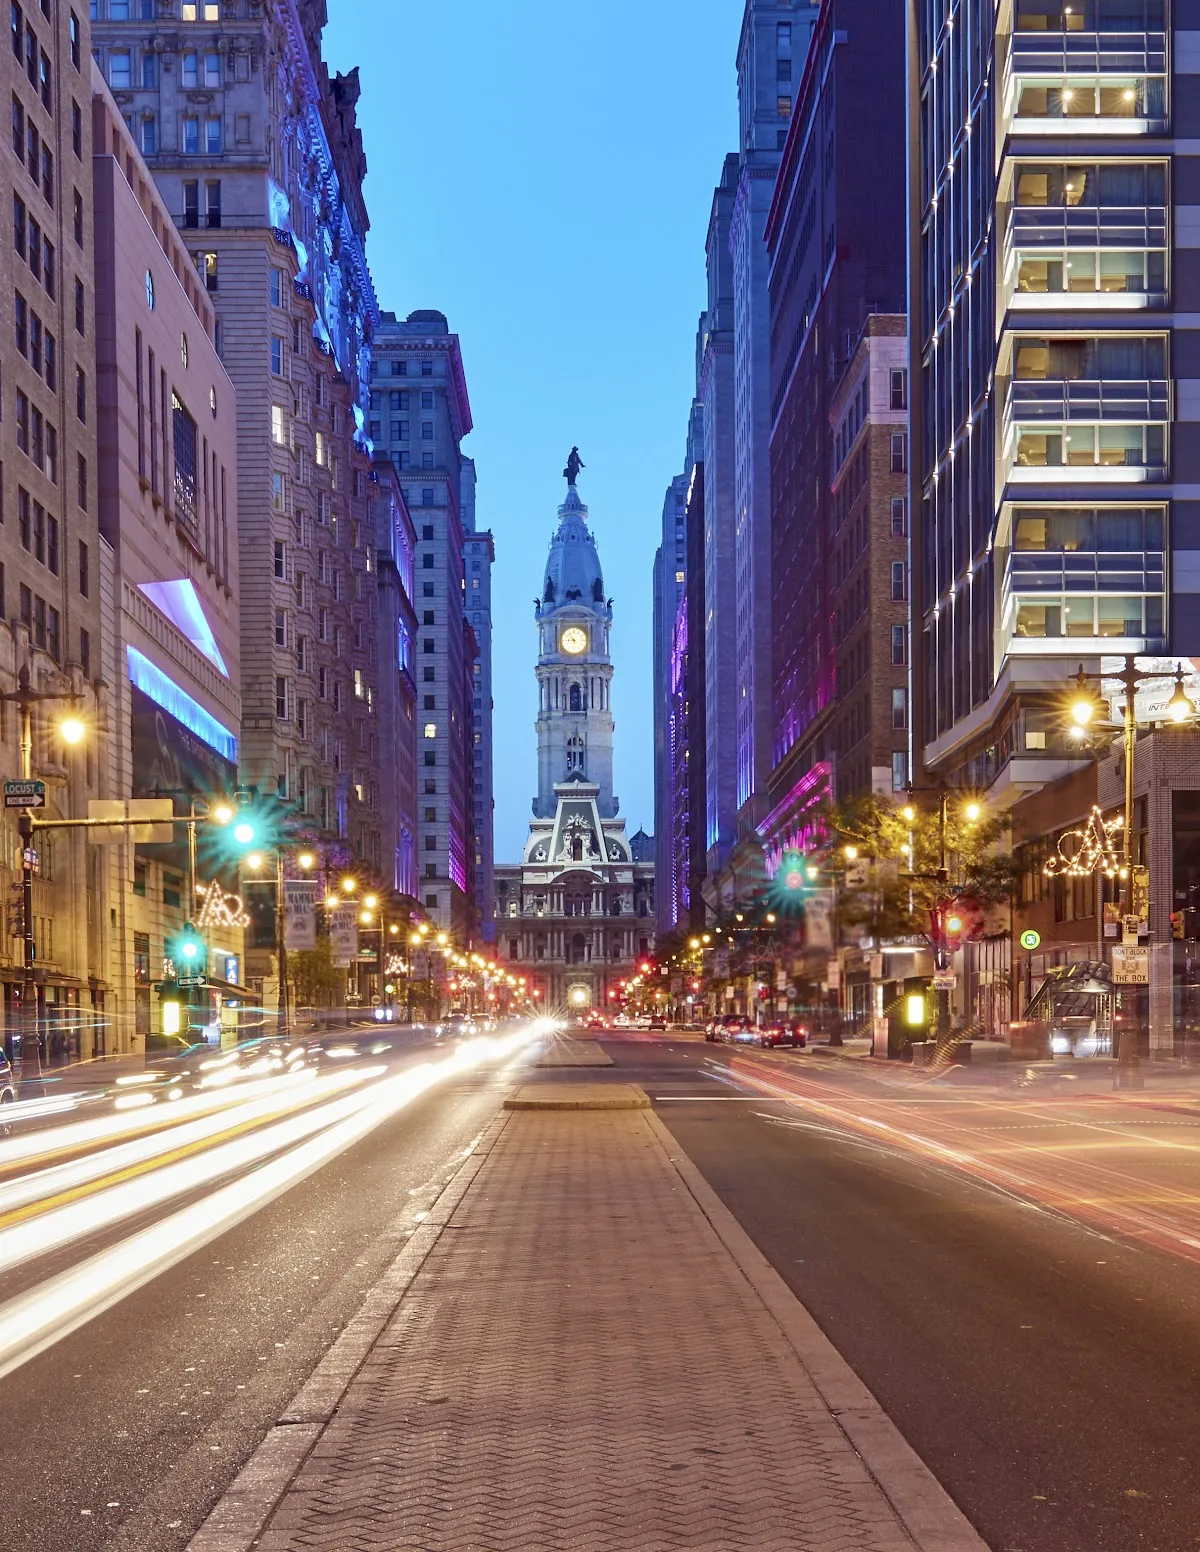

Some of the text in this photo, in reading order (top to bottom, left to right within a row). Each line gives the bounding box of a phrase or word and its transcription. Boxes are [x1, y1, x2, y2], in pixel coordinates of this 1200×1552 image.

[5, 784, 35, 793] LOCUST
[1115, 974, 1147, 982] THE BOX
